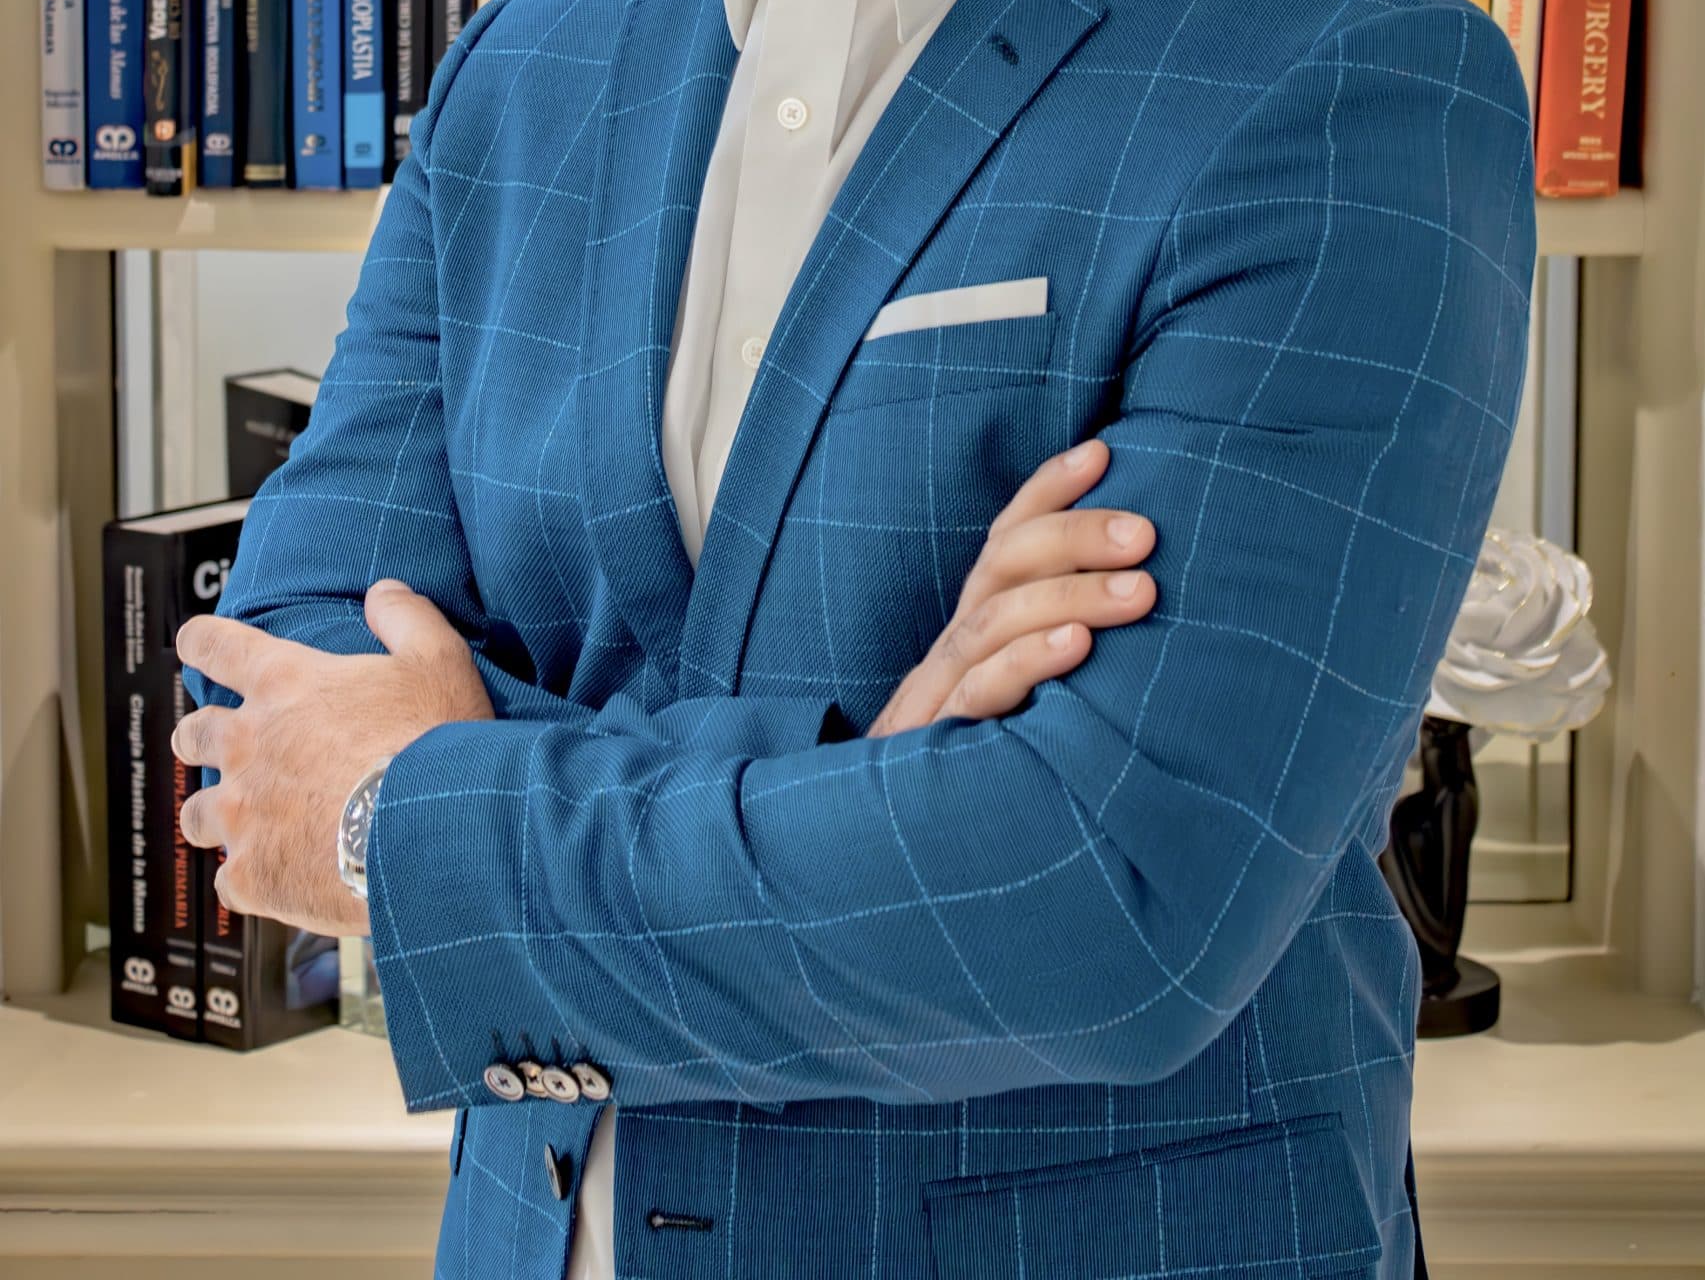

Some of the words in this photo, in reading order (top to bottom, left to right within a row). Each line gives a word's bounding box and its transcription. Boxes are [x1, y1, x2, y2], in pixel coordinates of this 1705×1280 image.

[110, 5, 127, 23] de
[110, 24, 127, 44] las
[398, 30, 411, 48] DE
[109, 49, 127, 99] Mamas
[398, 49, 411, 101] MANUAL
[128, 694, 145, 758] Cirugía
[131, 760, 147, 830] Plástica
[132, 832, 147, 856] de
[132, 859, 147, 877] la
[132, 878, 148, 933] Mama
[174, 848, 188, 929] PRIMARIA
